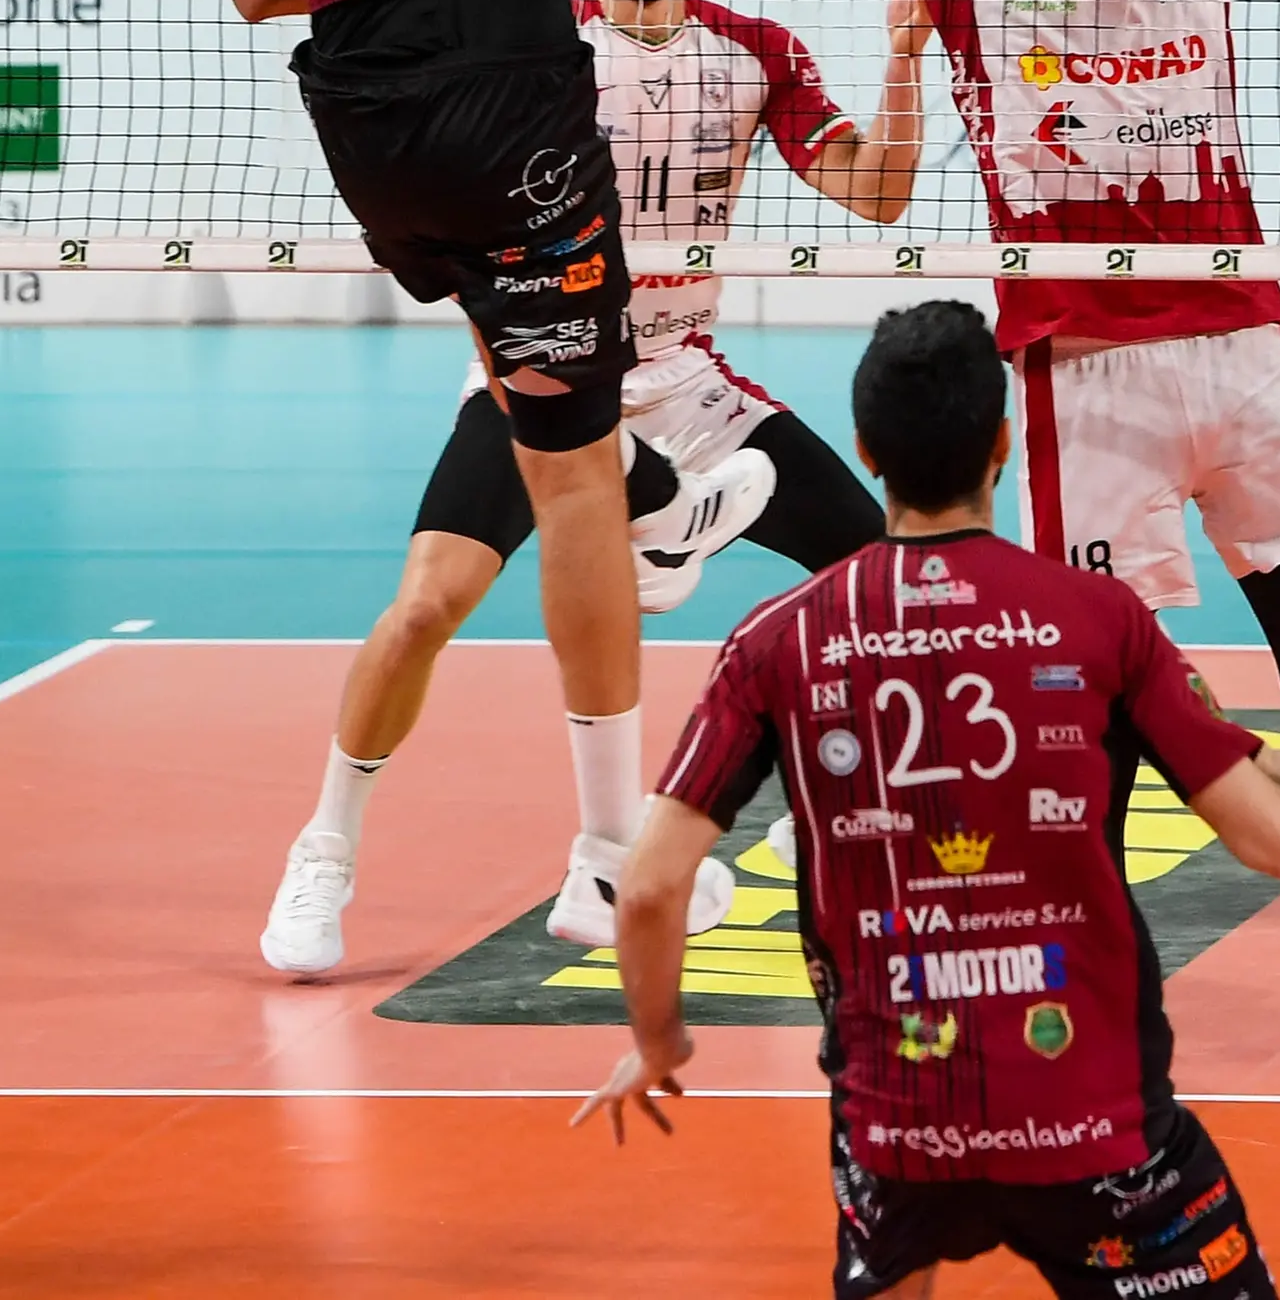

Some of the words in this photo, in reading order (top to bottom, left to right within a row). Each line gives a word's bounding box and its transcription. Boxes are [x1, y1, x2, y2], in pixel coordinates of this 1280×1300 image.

[1065, 34, 1208, 85] CONAD
[639, 155, 669, 213] 11
[556, 316, 598, 340] SEA
[1070, 540, 1114, 577] 18
[821, 610, 1062, 666] #lazzaretto
[875, 673, 1017, 788] 23
[958, 908, 1036, 932] service
[867, 1114, 1114, 1161] #reggiocalabria
